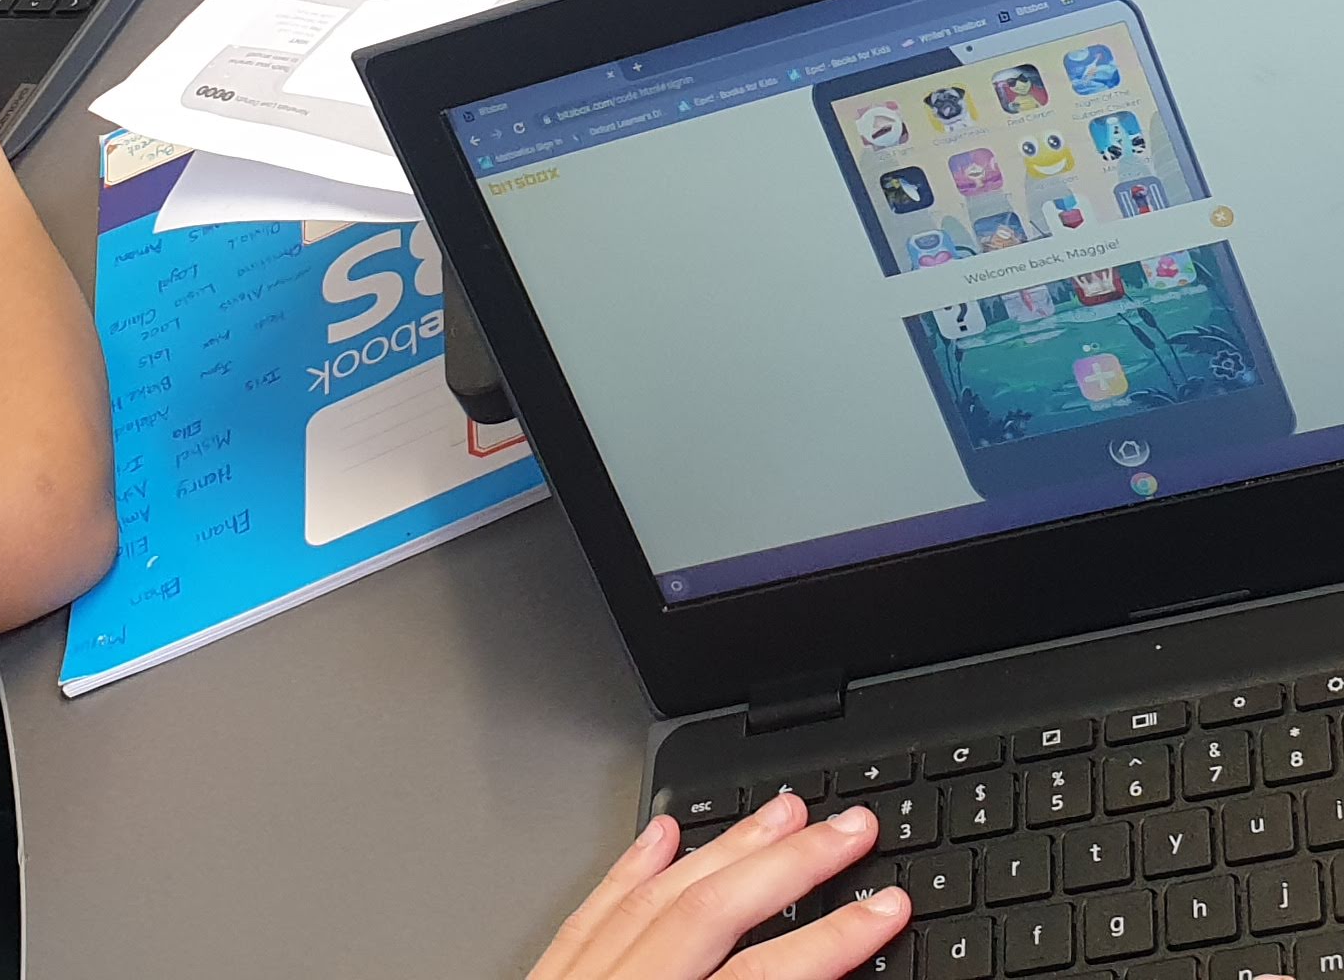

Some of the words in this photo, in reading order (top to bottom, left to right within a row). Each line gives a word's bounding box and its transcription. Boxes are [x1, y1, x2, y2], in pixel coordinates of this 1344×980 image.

[1015, 1, 1050, 18] Bitsbox
[487, 166, 561, 197] bitsbox
[963, 262, 1028, 286] Welcome
[1028, 248, 1066, 271] back,
[1065, 237, 1121, 264] Maggie!
[245, 367, 282, 391] Iris
[176, 463, 233, 500] Henry
[1289, 749, 1305, 769] 8
[1209, 764, 1223, 784] 7
[1128, 779, 1143, 797] 6
[690, 799, 714, 814] esc
[1050, 793, 1065, 812] 5
[1335, 799, 1344, 820] i
[973, 807, 987, 826] 4
[1250, 815, 1266, 835] u
[899, 822, 913, 841] 3
[1089, 842, 1103, 862] t
[1168, 832, 1184, 856] y
[1010, 858, 1022, 877] r
[932, 872, 947, 891] e
[1277, 880, 1290, 911] j
[1192, 896, 1208, 919] h
[1032, 924, 1044, 947] f
[1109, 914, 1125, 939] g
[950, 937, 966, 960] d
[874, 955, 888, 973] s
[1318, 950, 1344, 972] m
